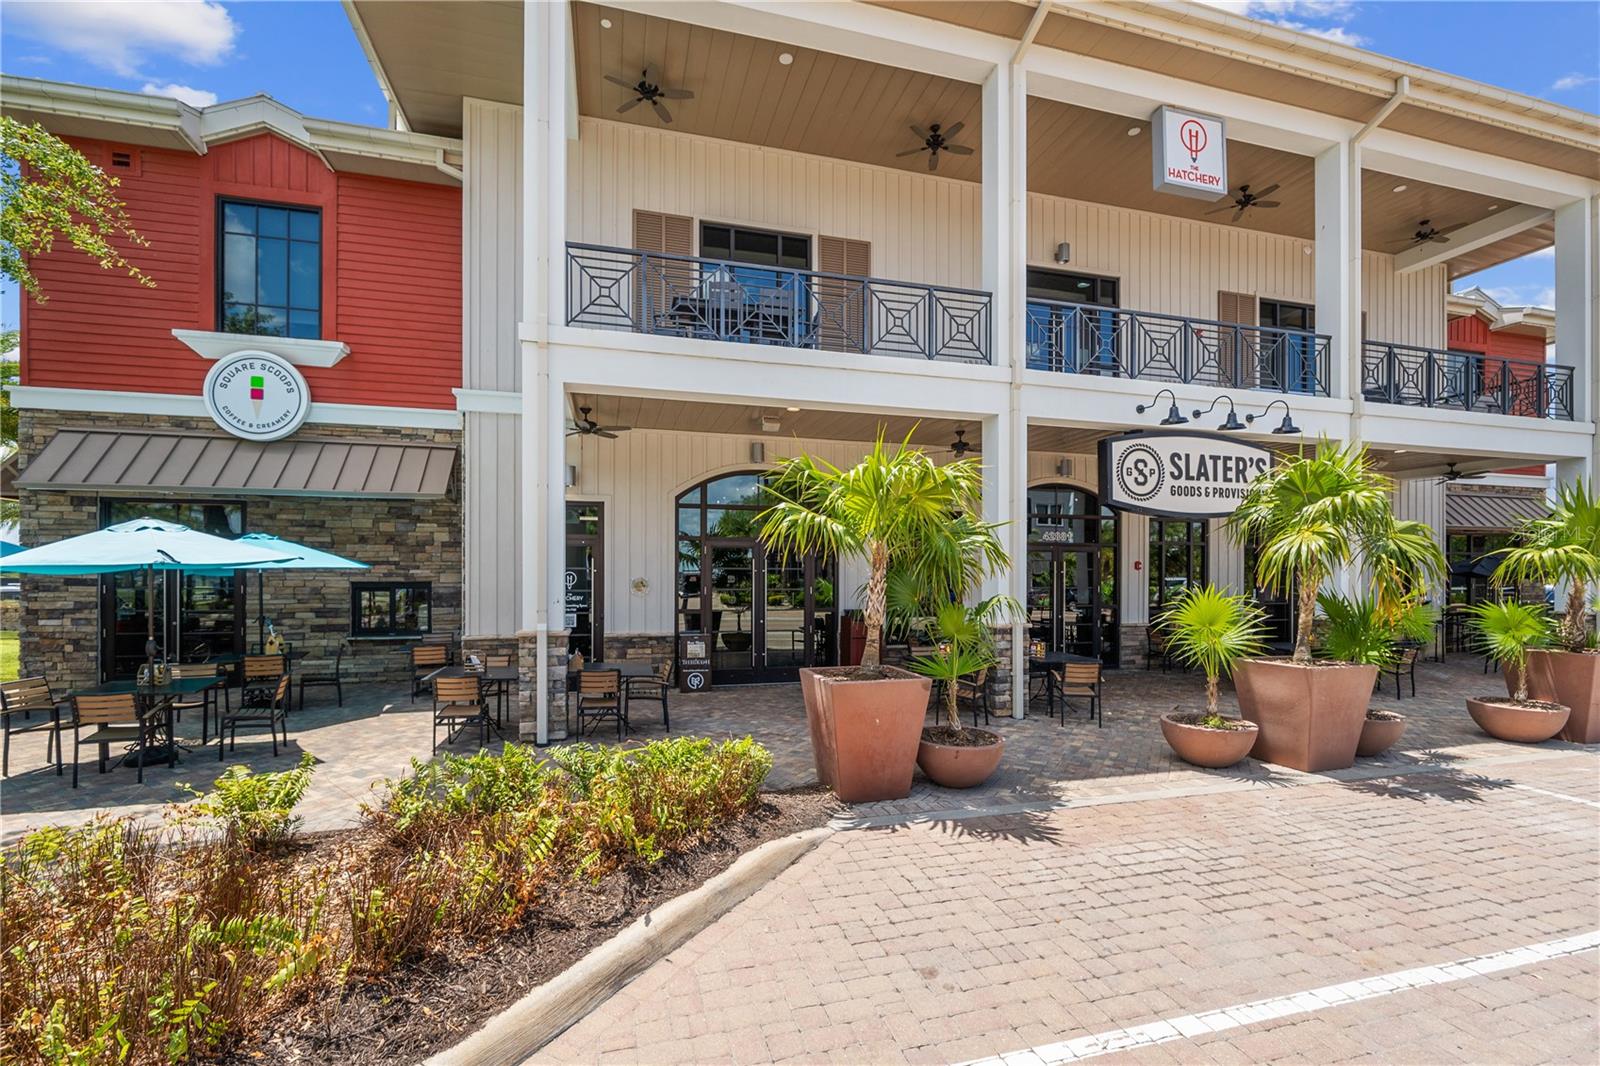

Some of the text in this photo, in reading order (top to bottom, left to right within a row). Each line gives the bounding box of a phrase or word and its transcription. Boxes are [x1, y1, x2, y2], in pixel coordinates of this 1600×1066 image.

[1168, 168, 1220, 186] HATCHERY
[220, 363, 294, 394] SQUARE SCOOPS
[222, 405, 246, 425] COFFEE
[256, 409, 291, 429] CREAMERY
[1170, 452, 1267, 483] SLATER'S
[1170, 485, 1202, 497] GOODS
[1205, 487, 1210, 497] &
